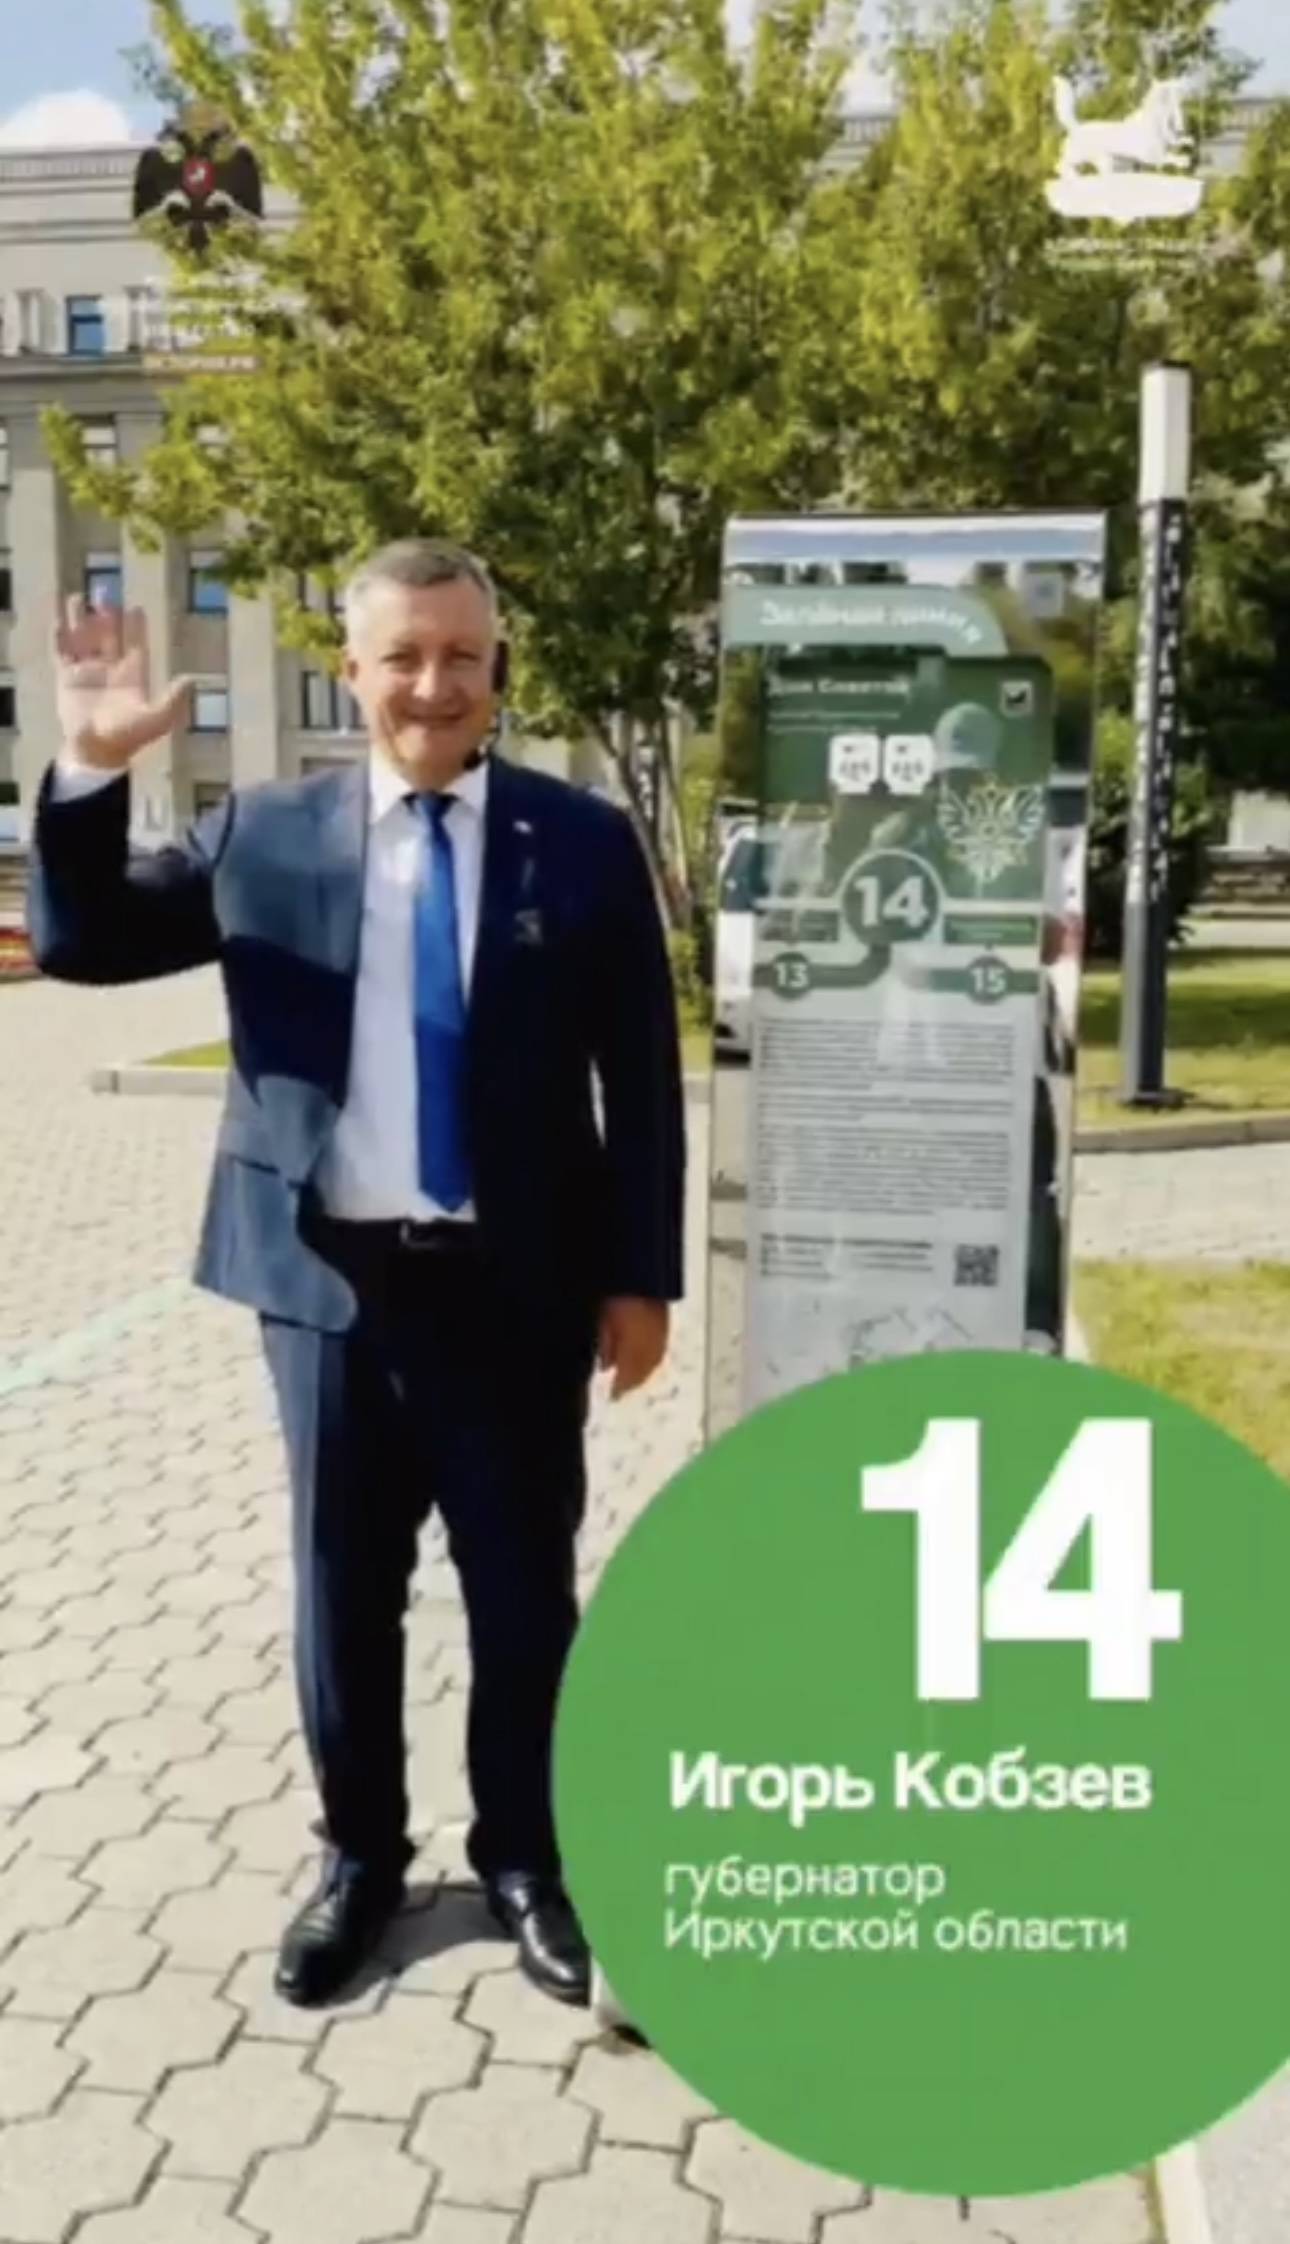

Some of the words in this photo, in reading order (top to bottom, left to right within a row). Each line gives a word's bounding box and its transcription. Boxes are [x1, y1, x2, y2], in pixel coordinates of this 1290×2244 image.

[854, 875, 929, 928] 14
[775, 962, 809, 988] 13
[971, 966, 1007, 993] 15
